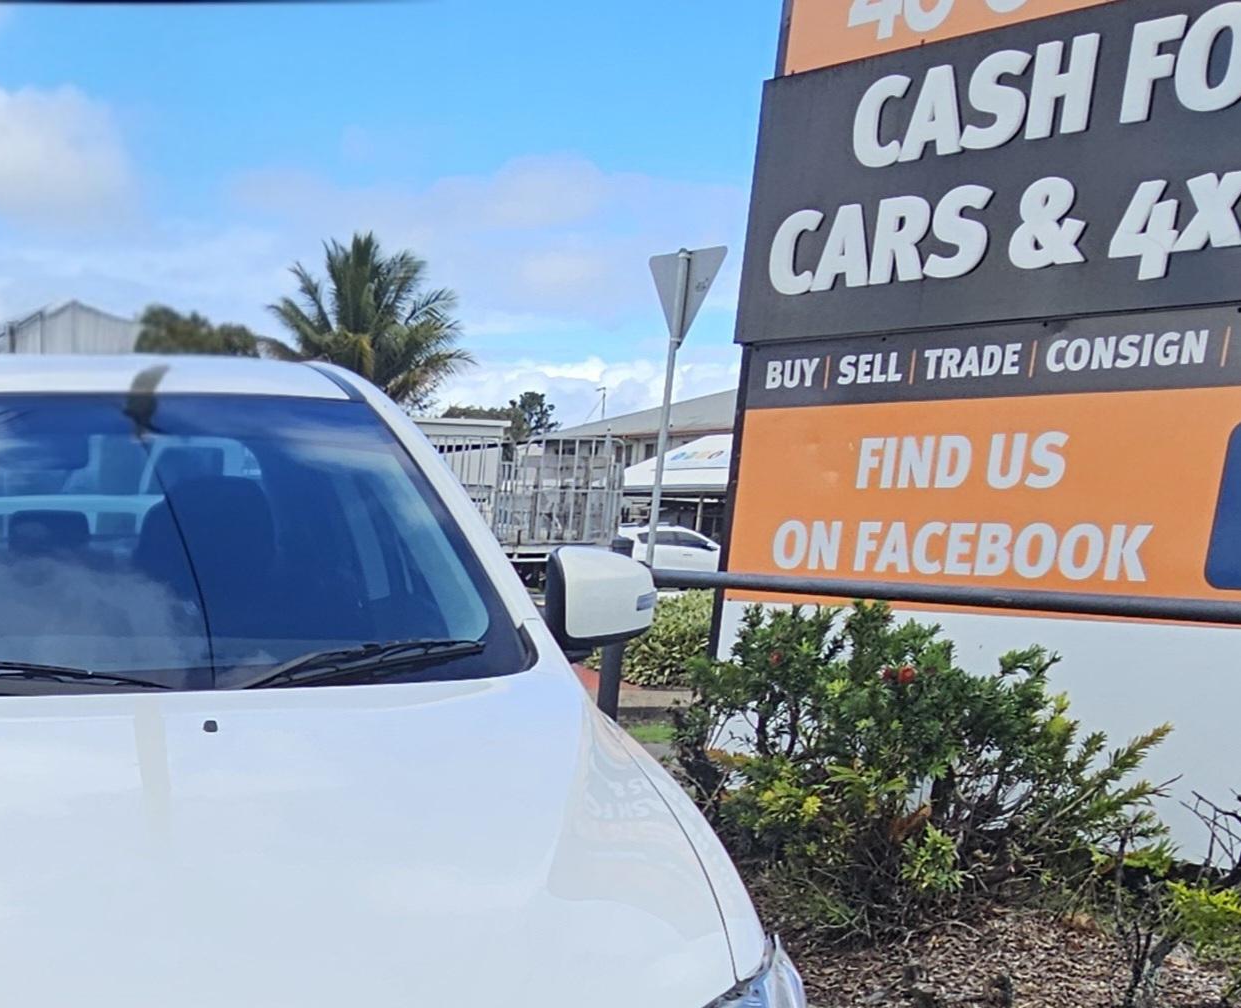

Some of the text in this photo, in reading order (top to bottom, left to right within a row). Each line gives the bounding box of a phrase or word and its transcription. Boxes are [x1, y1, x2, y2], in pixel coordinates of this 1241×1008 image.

[853, 33, 1100, 167] CASH
[768, 185, 994, 295] CARS
[1008, 176, 1087, 270] &
[765, 329, 1210, 390] BUY SELL TRADE CONSIGN
[855, 431, 1070, 490] FIND US
[772, 519, 1154, 583] ON FACEBOOK
